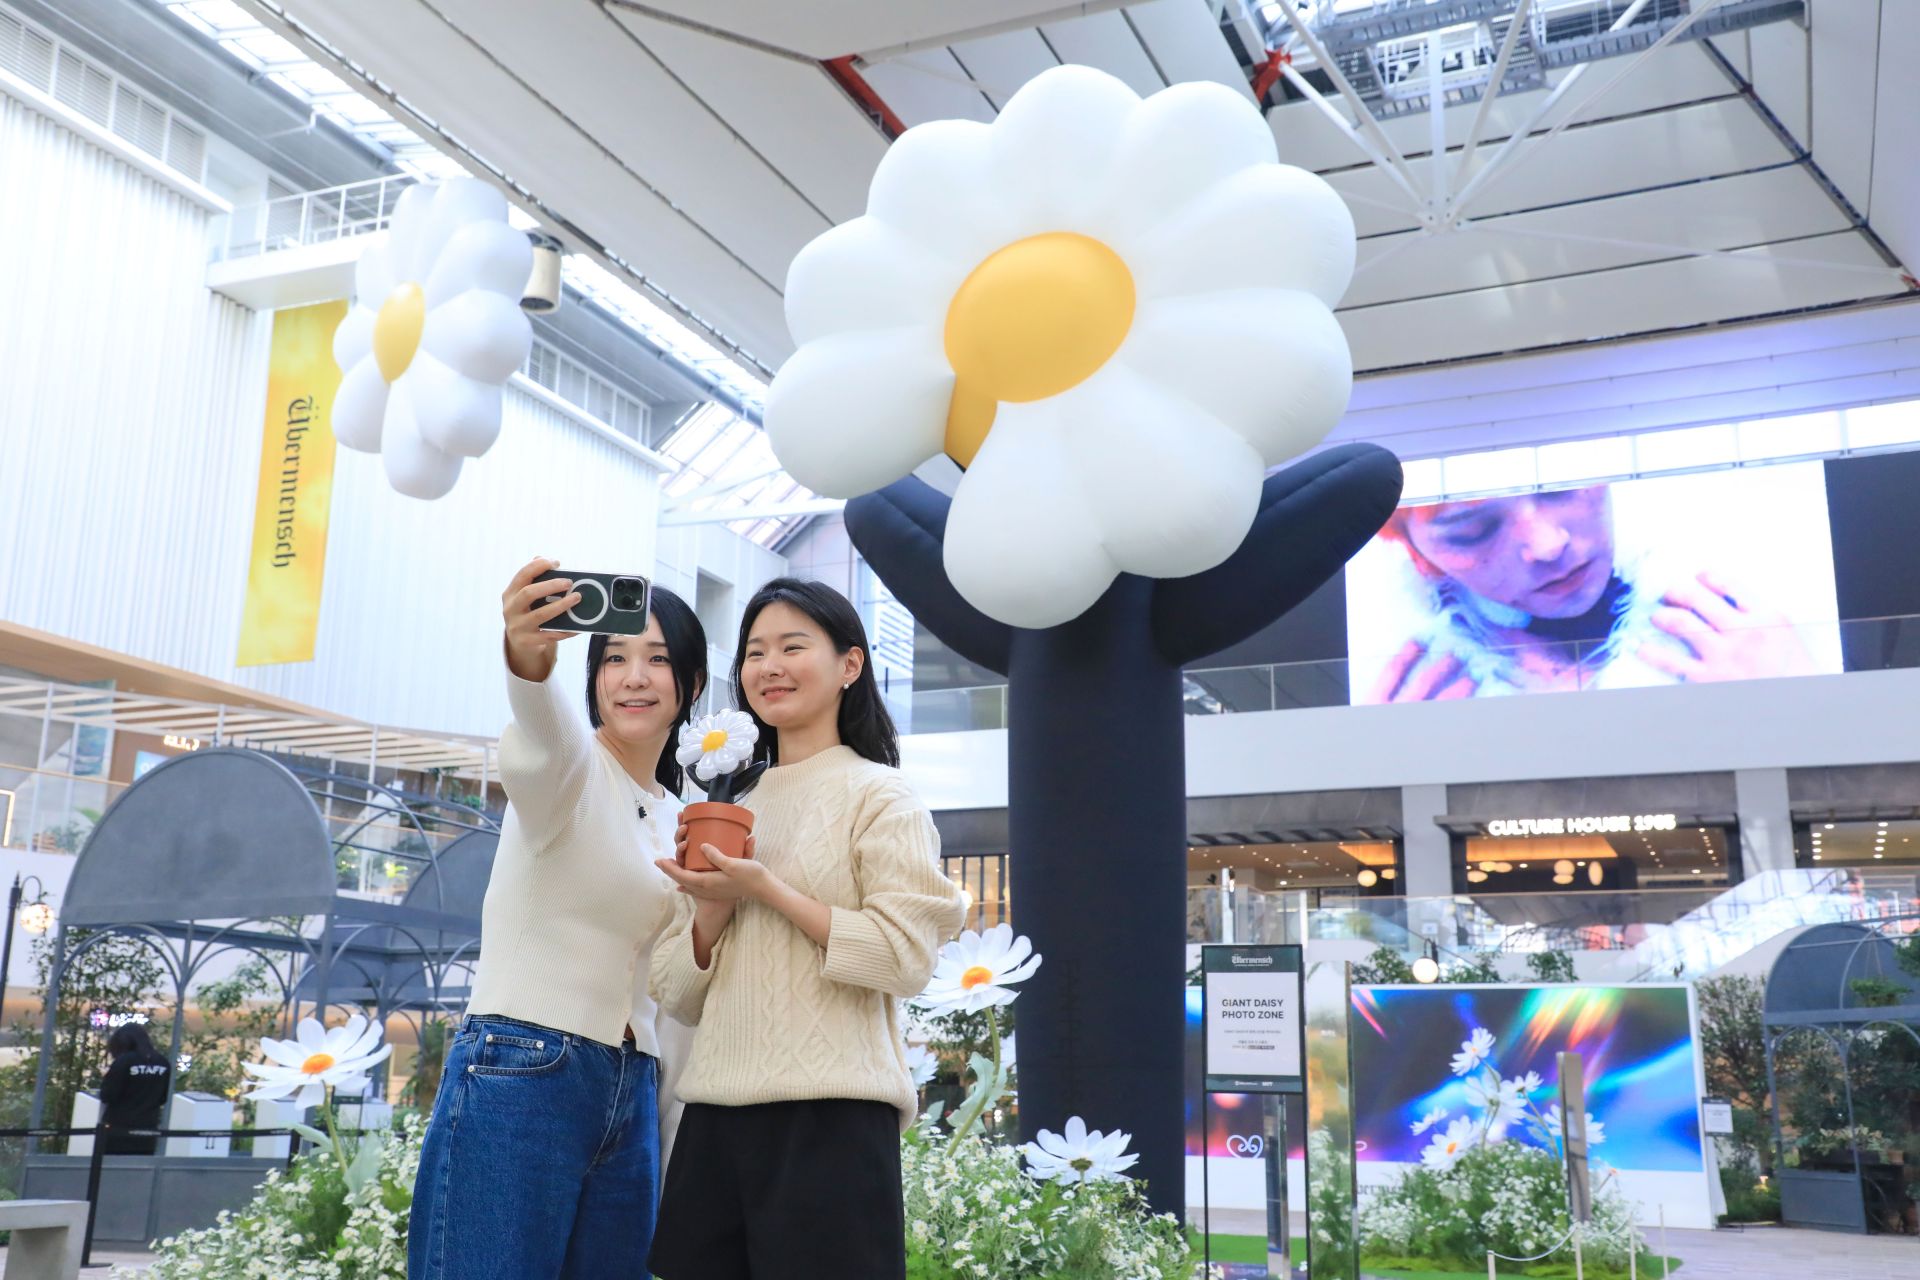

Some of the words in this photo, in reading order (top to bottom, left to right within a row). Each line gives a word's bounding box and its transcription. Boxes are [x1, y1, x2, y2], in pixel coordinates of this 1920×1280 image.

[1488, 818, 1565, 836] CULTURE
[1567, 816, 1631, 833] HOUSE
[1222, 999, 1251, 1007] GIANT
[1254, 999, 1284, 1007] DAISY
[1222, 1011, 1255, 1019] PHOTO
[1258, 1011, 1284, 1019] ZONE
[129, 1065, 167, 1076] STAFF
